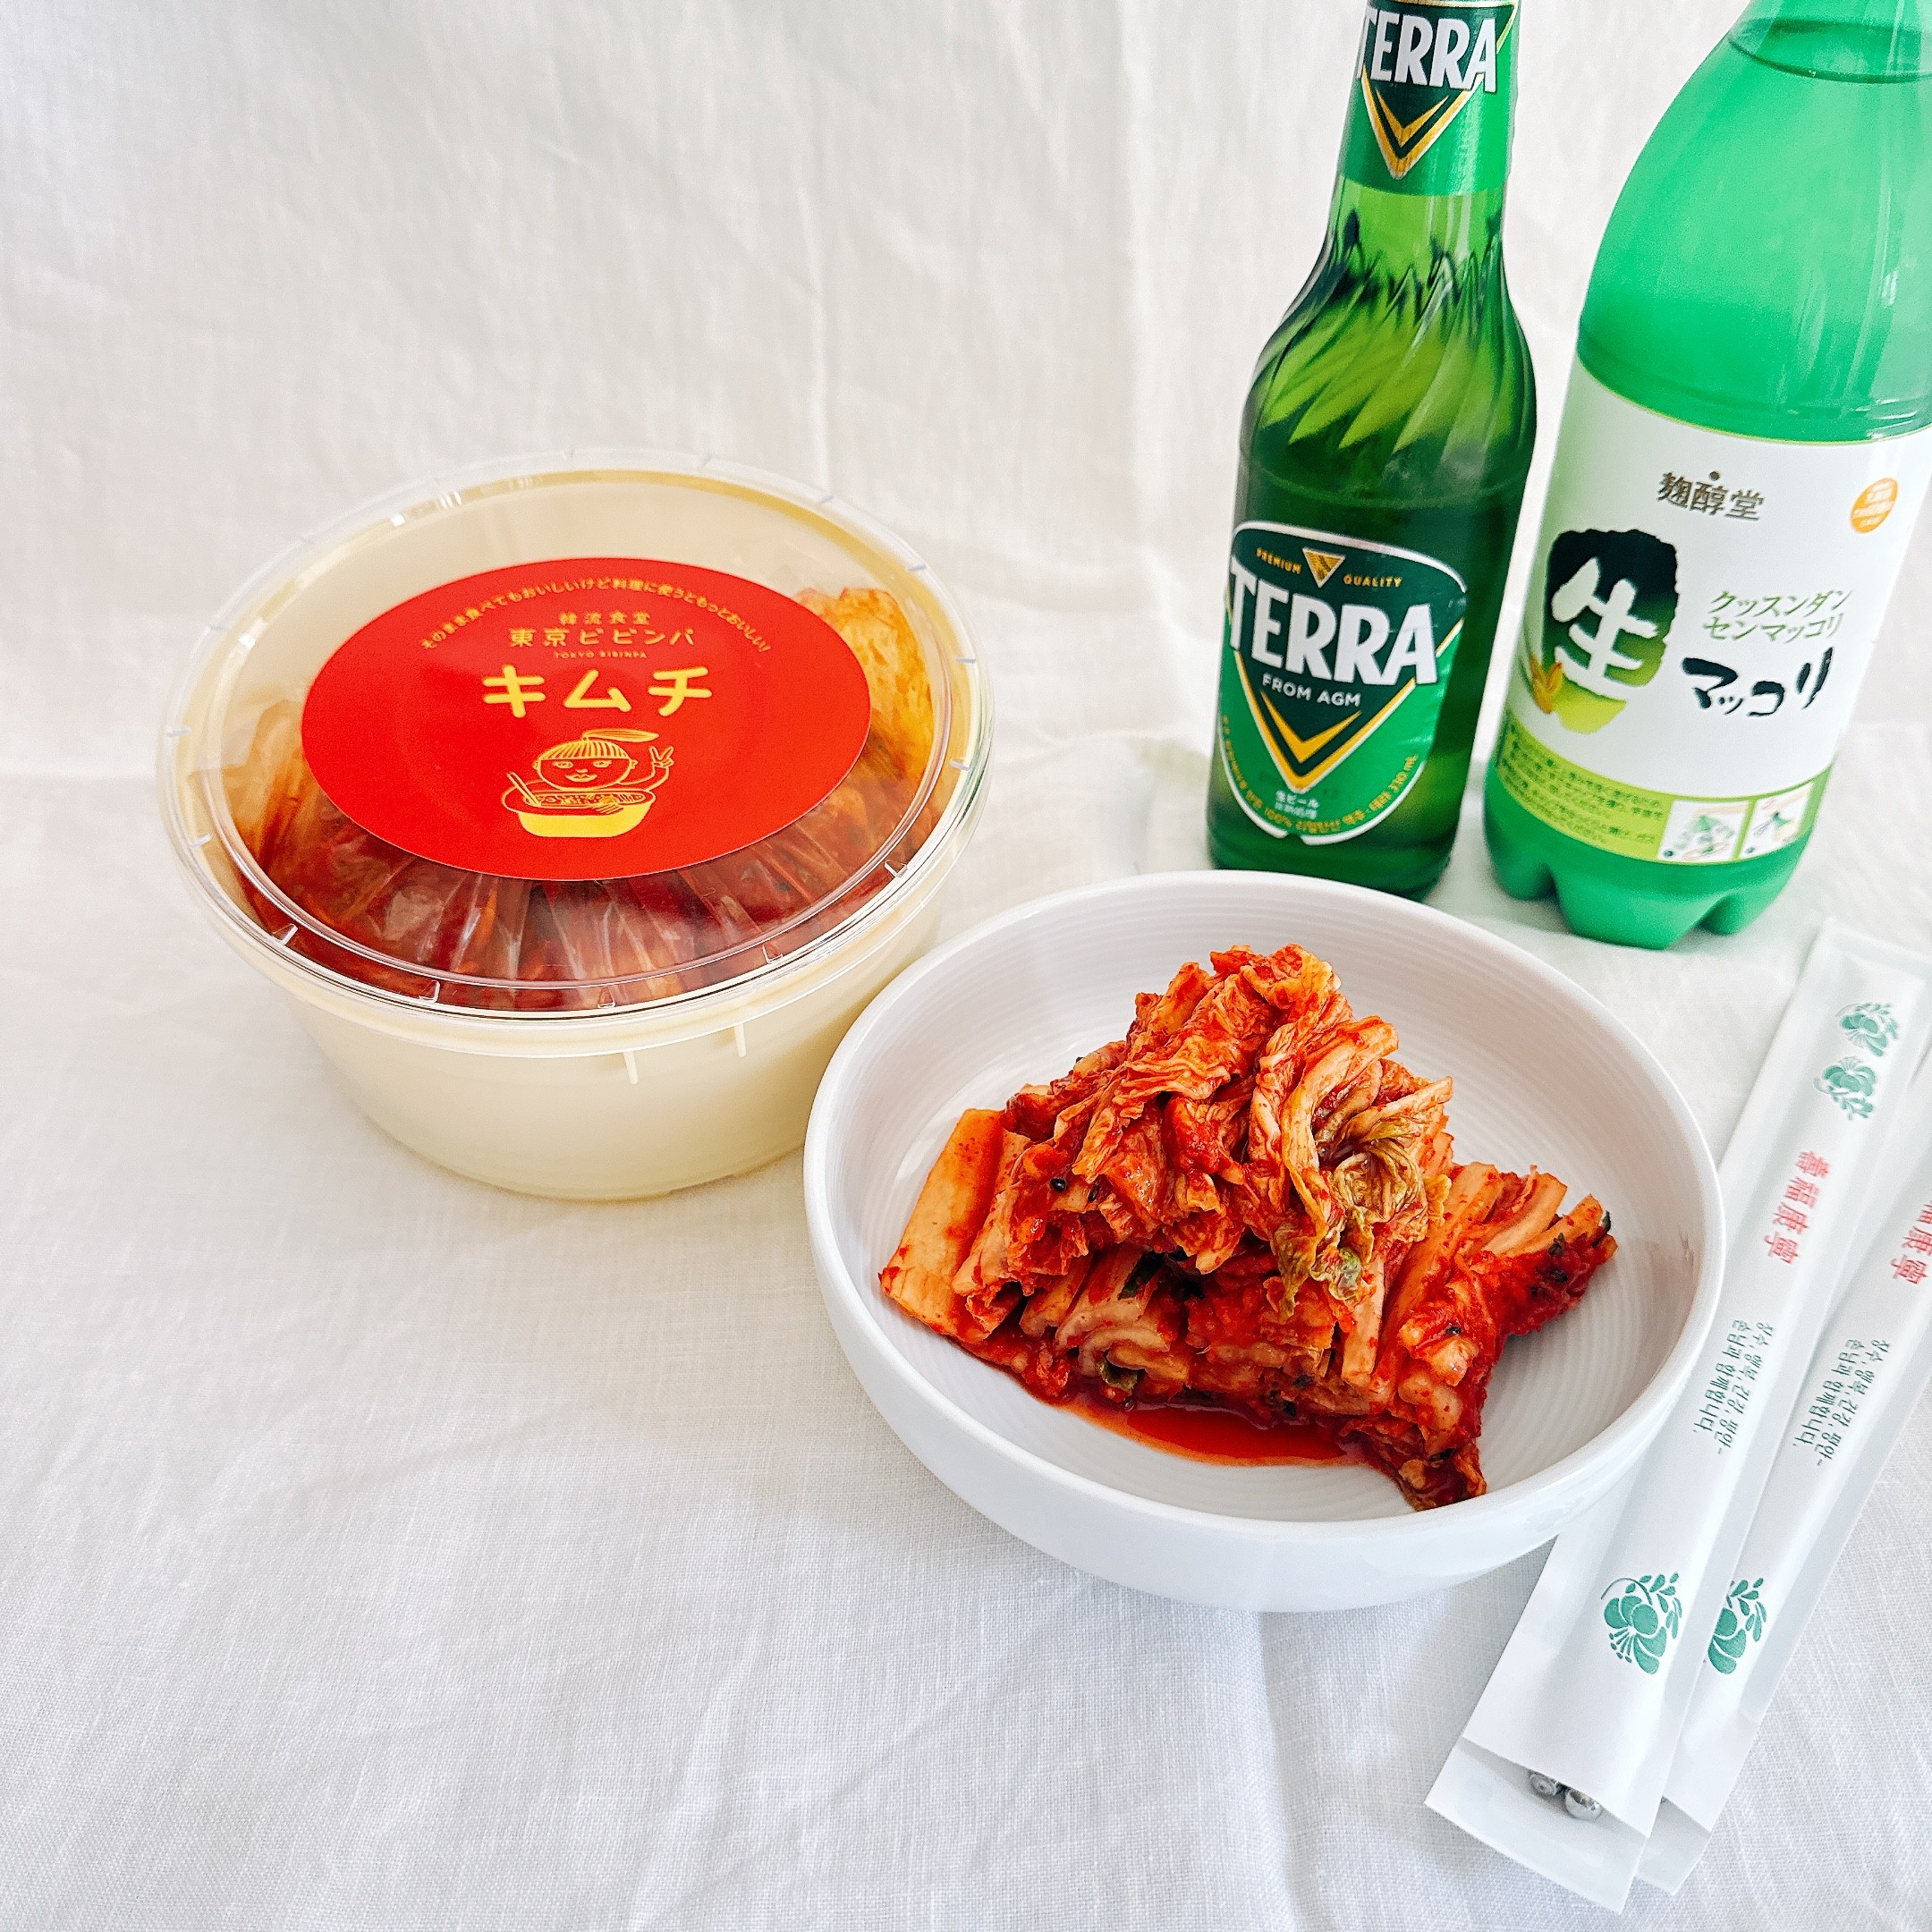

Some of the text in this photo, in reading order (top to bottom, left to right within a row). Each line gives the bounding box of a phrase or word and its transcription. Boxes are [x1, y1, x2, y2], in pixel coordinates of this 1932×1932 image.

[1256, 547, 1402, 588] PREMIUM QUALITY
[559, 610, 651, 625] 韓流食堂
[1230, 555, 1438, 686] TERRA
[1707, 590, 1852, 617] クッスンダン
[509, 628, 694, 647] 東京ビビンパ
[1551, 555, 1659, 701] 生
[1703, 613, 1844, 644] センマッコリ
[554, 650, 648, 659] TOKYO BIBINPA
[483, 665, 712, 718] キムチ
[1262, 673, 1362, 707] FROM AGM
[1682, 647, 1834, 716] マッコリ
